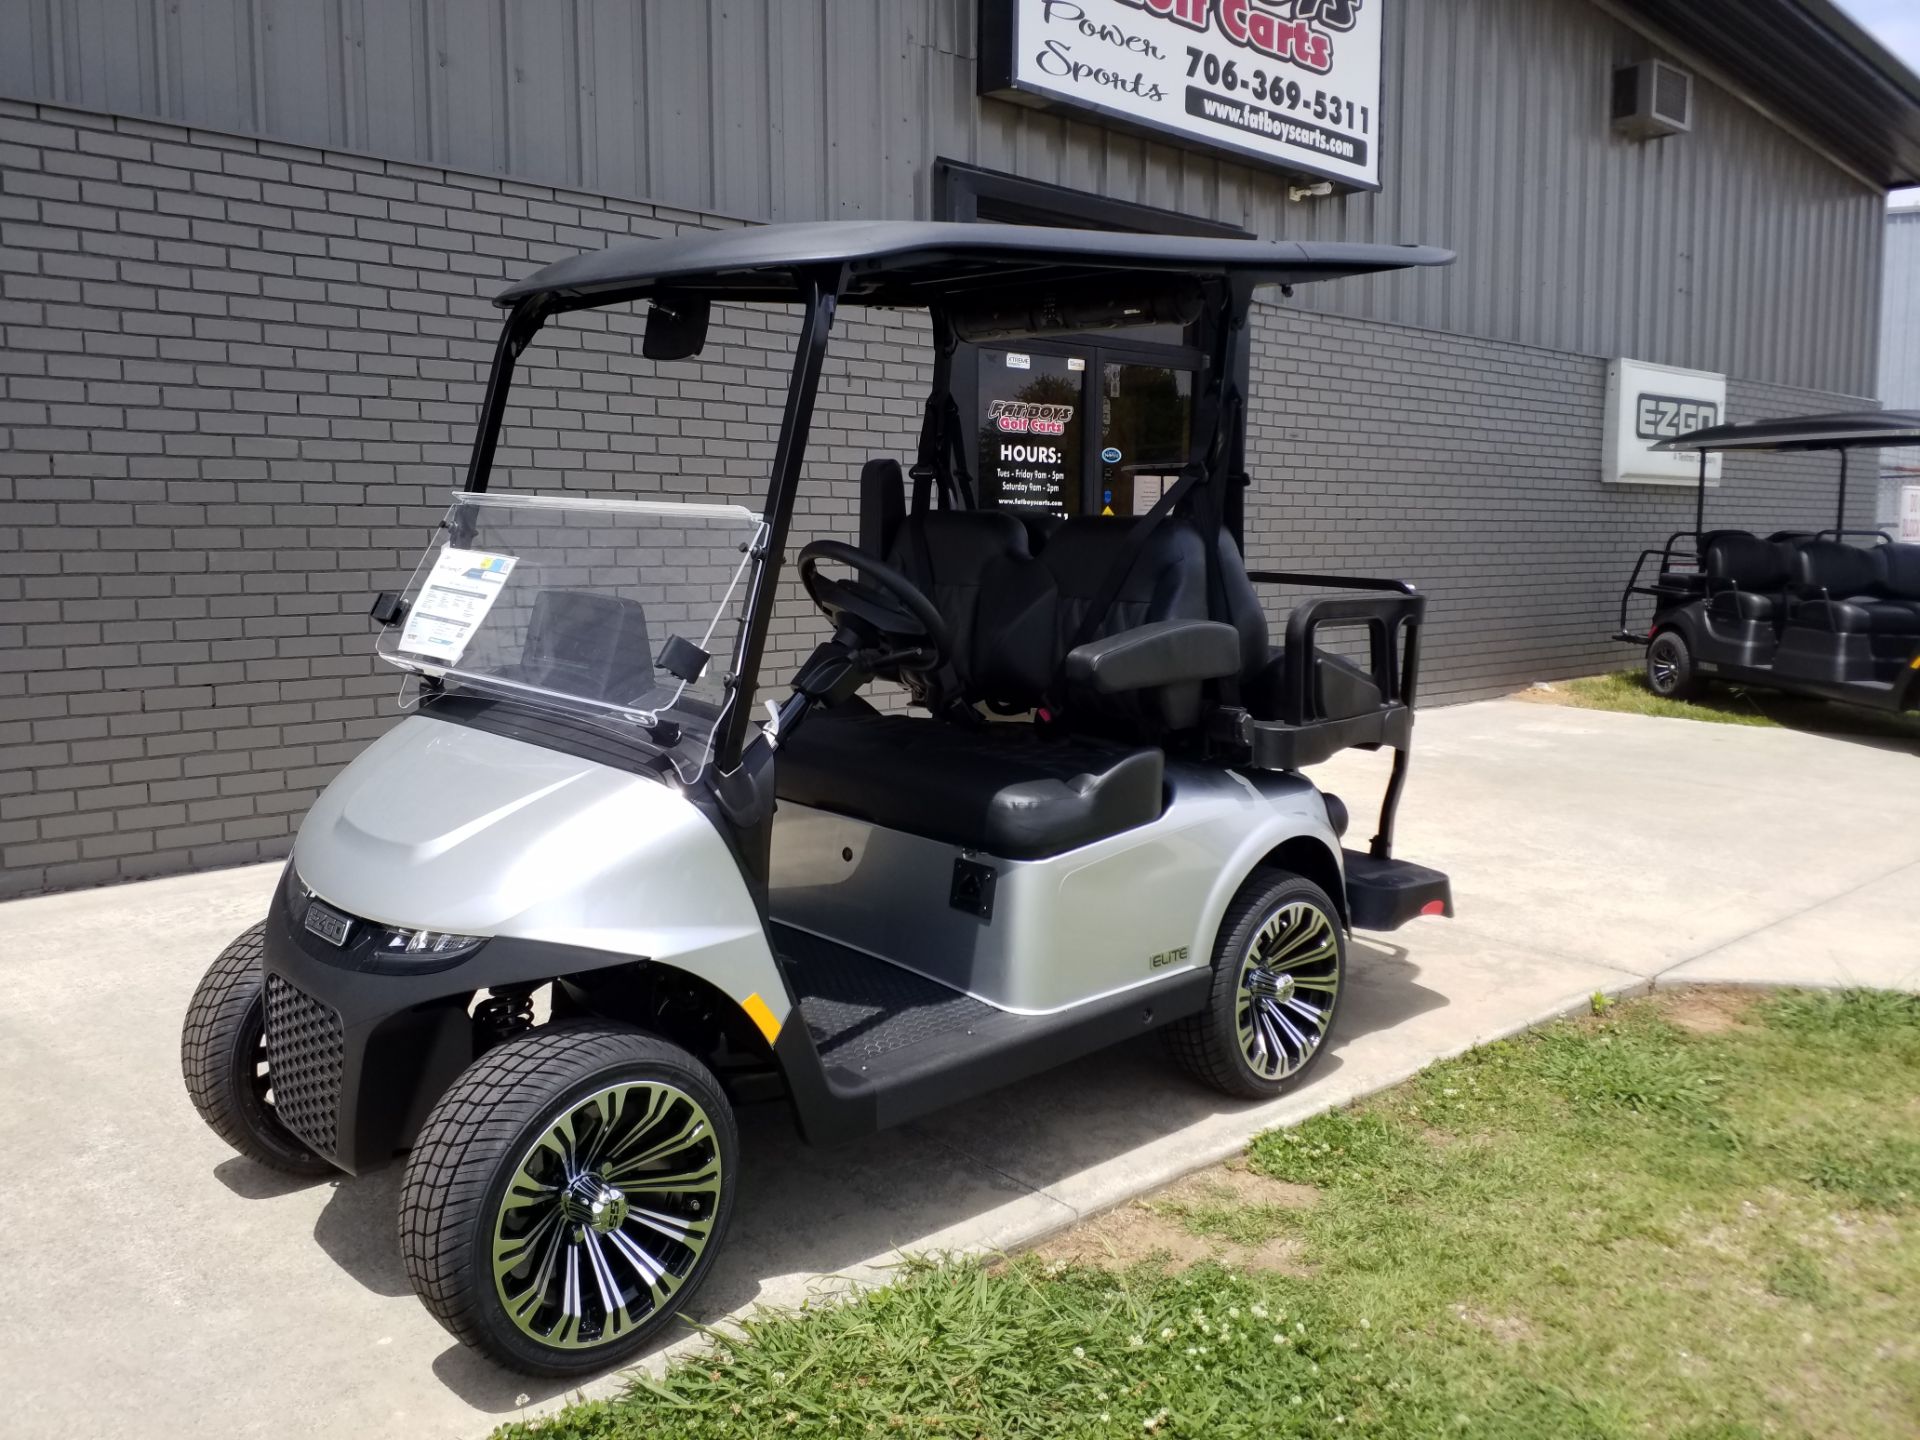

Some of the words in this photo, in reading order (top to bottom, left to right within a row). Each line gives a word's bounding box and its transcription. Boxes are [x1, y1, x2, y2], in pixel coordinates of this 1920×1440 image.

[1041, 0, 1166, 60] Power
[1219, 0, 1331, 71] Carts
[1036, 40, 1168, 101] Sports
[1186, 46, 1369, 134] 706-369-5311
[1203, 98, 1354, 158] www.fatboyscarts.com
[989, 401, 1028, 418] FAT
[1027, 404, 1073, 422] BOYS
[1000, 417, 1028, 431] Golf
[1030, 419, 1062, 433] Carts
[1000, 444, 1062, 464] HOURS:
[997, 468, 1010, 477] Tues
[1016, 469, 1034, 480] Friday
[1034, 470, 1047, 479] 9am
[1052, 471, 1064, 481] 5pm
[1002, 481, 1028, 493] Saturday
[1152, 947, 1188, 968] ELITE
